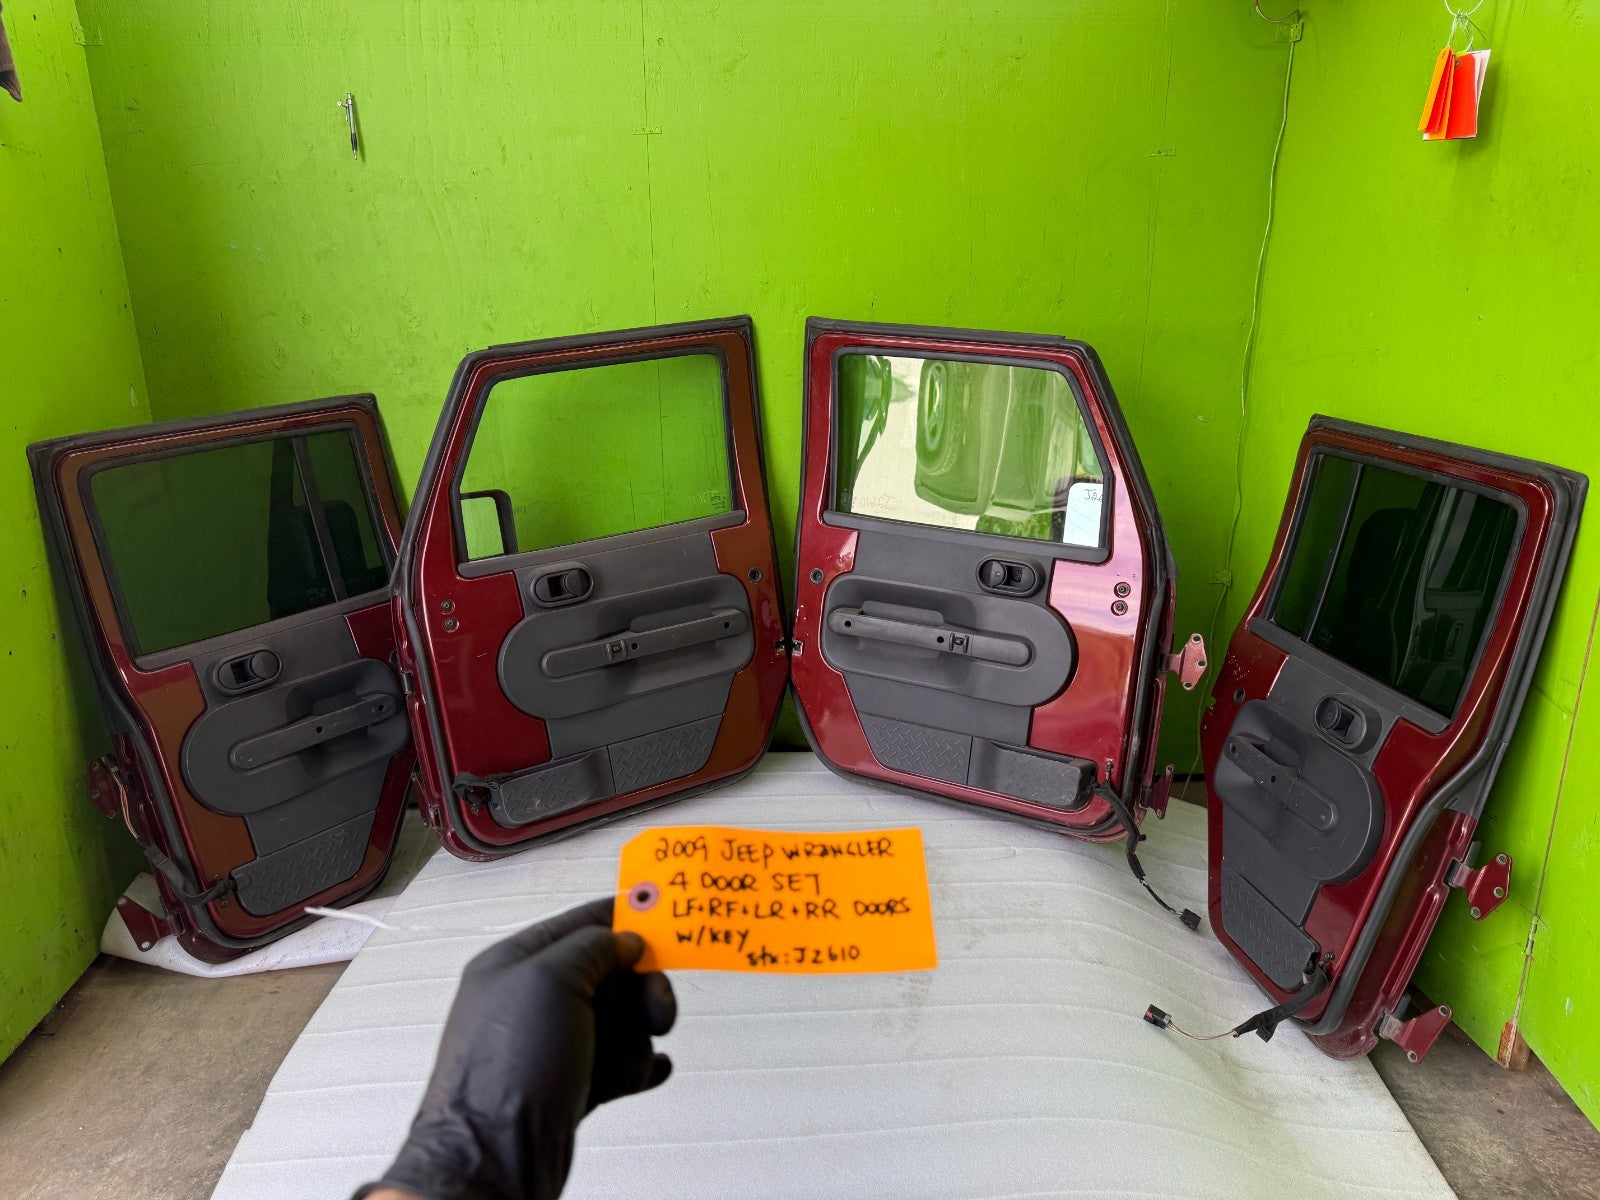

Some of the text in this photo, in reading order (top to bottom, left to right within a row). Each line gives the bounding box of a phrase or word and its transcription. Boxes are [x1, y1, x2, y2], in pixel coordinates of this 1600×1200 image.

[655, 836, 709, 862] 2009
[720, 838, 774, 869] JEEP
[669, 871, 820, 895] 4 DOOR SET
[854, 898, 911, 916] DOORS
